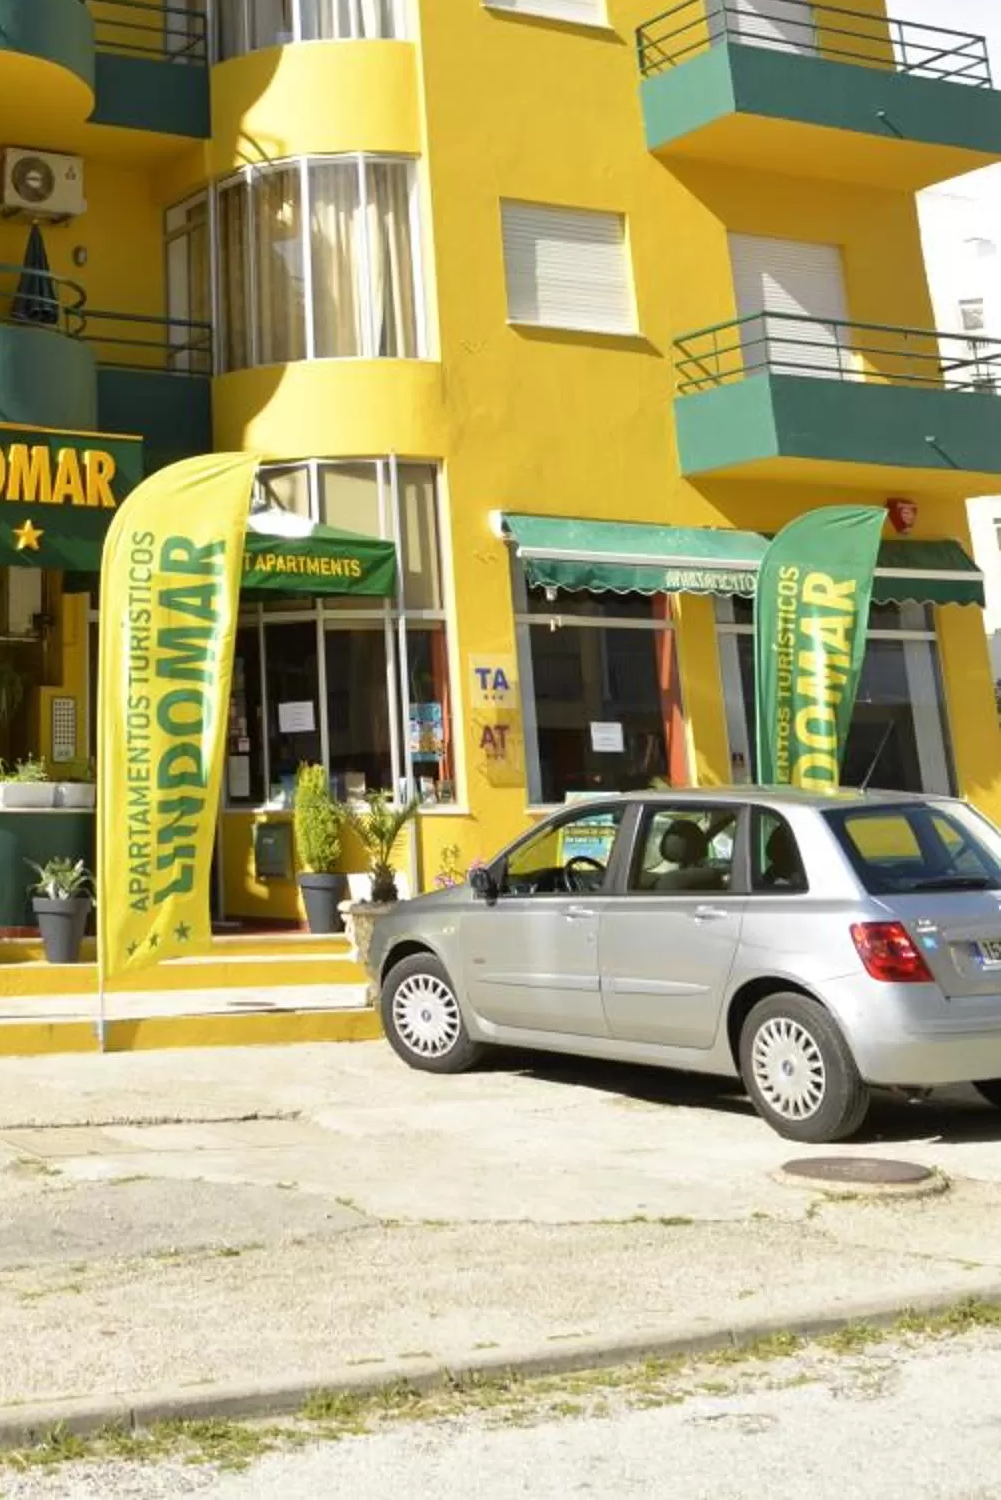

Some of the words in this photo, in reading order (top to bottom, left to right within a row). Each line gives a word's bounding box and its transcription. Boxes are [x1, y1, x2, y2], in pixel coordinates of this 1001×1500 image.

[120, 531, 155, 692] TURÍSTICOS
[254, 553, 362, 578] APARTMENTS
[665, 568, 757, 591] APARTAMENTO
[474, 667, 510, 690] TA
[771, 566, 800, 697] TURÍSTICOS
[792, 571, 858, 795] DOMAR
[153, 535, 227, 906] LINDOMAR
[480, 724, 510, 748] AT
[126, 696, 152, 913] APARTAMENTOS
